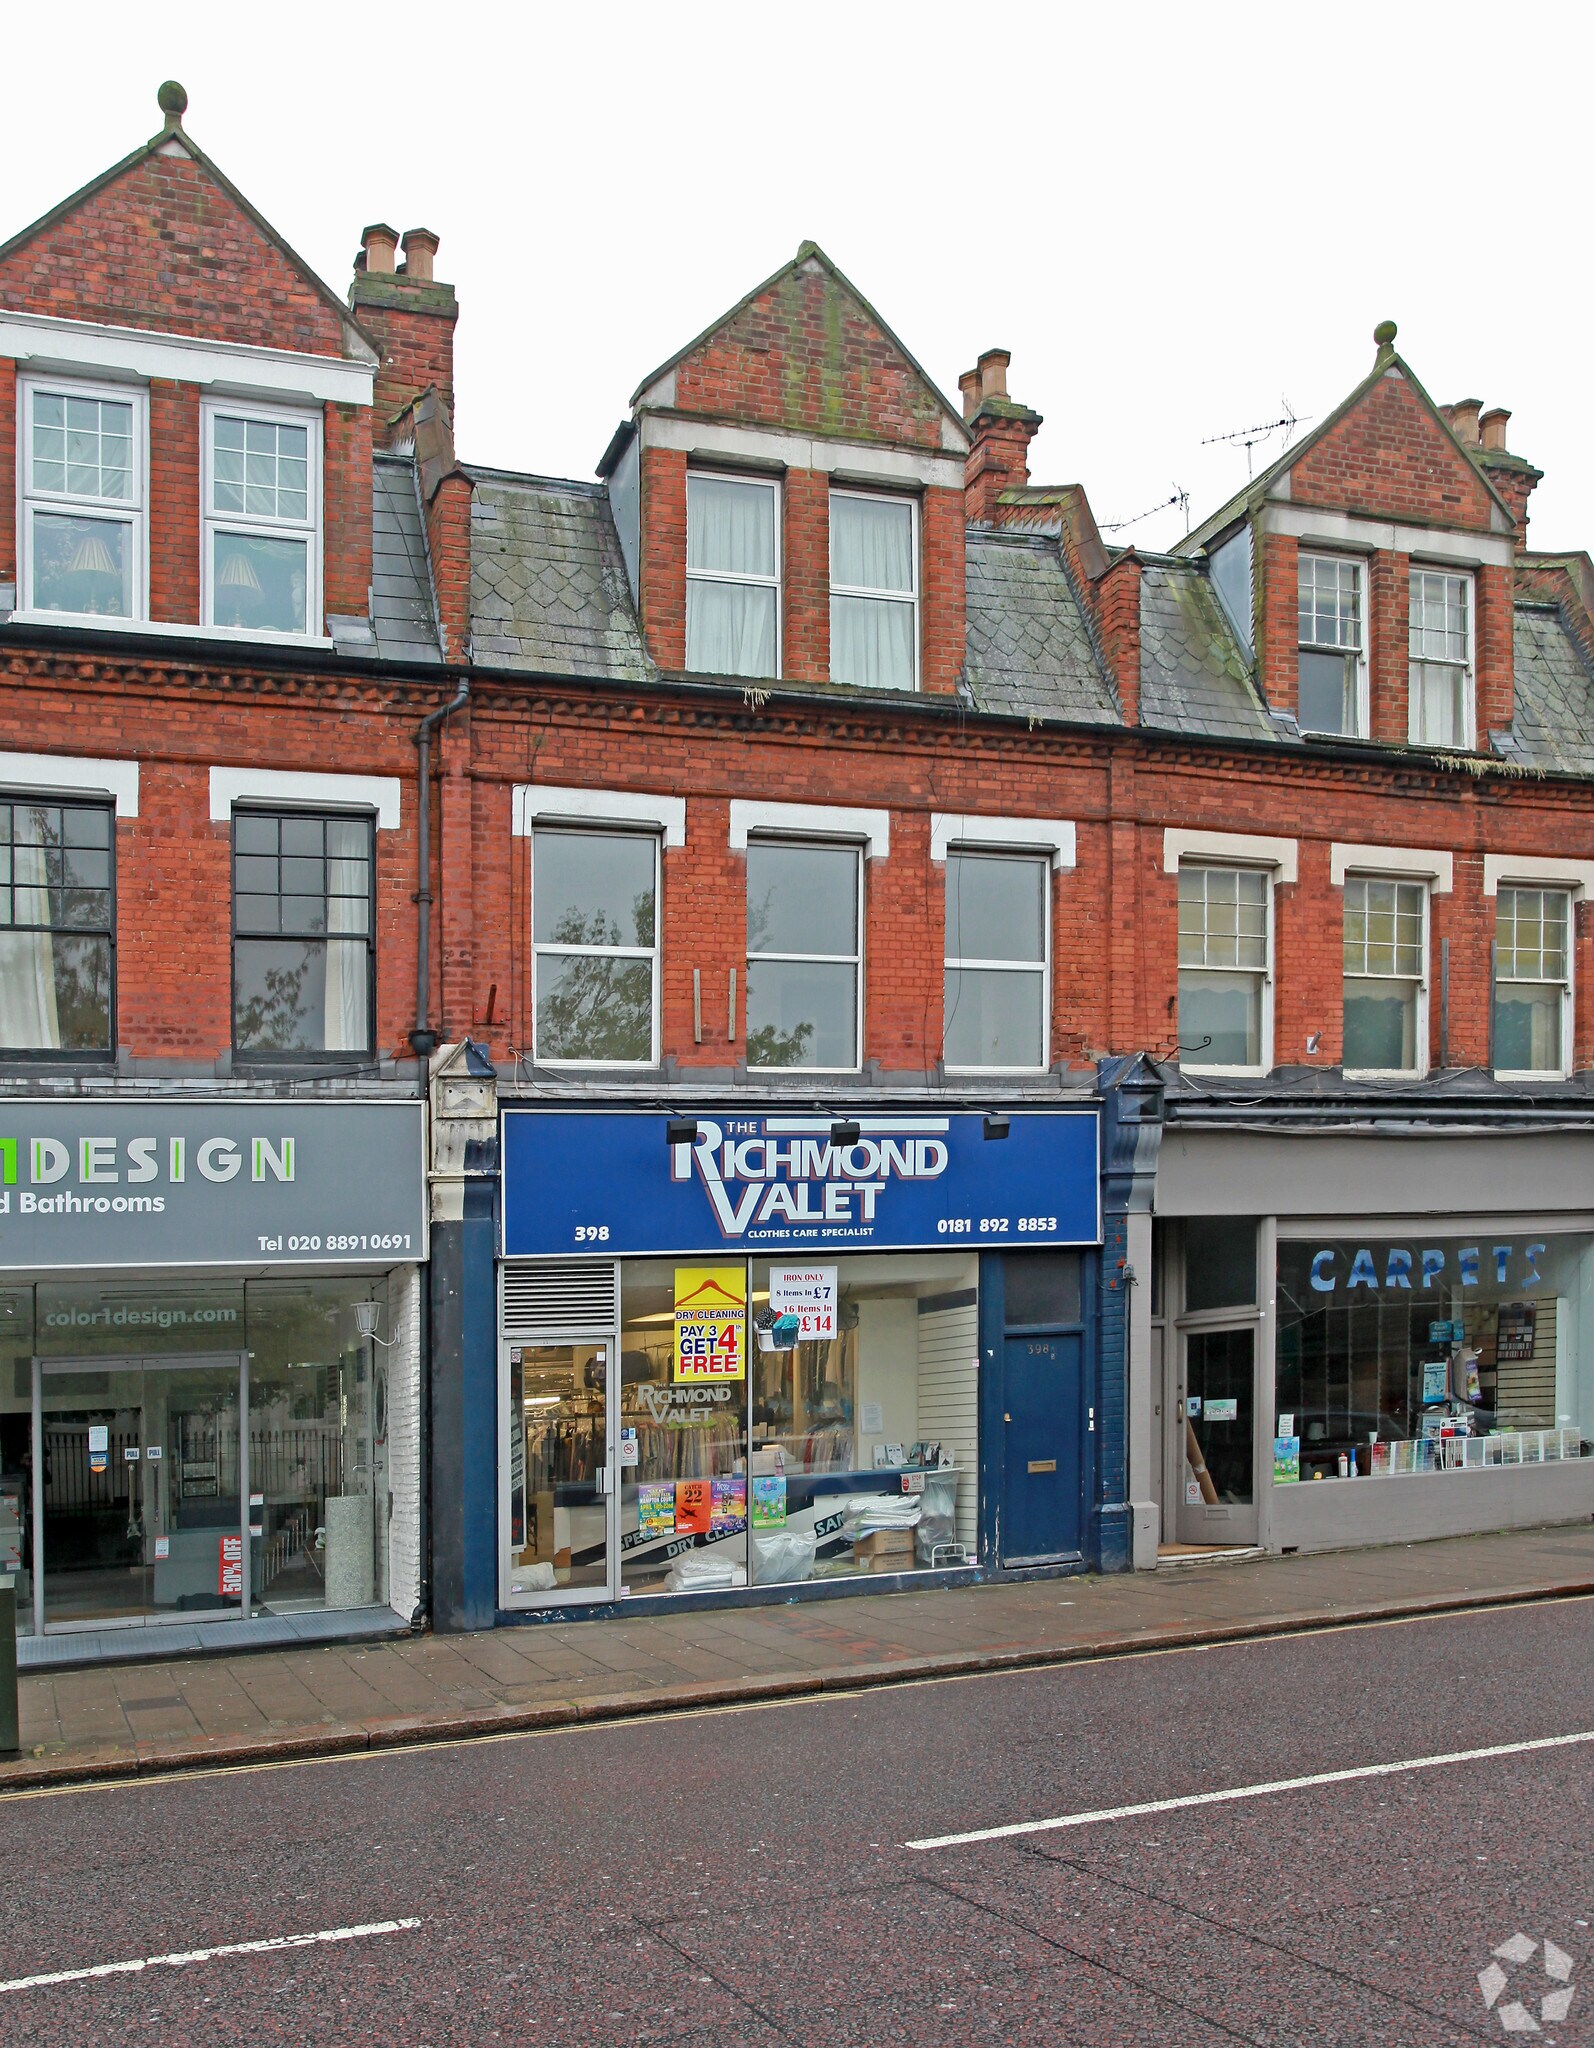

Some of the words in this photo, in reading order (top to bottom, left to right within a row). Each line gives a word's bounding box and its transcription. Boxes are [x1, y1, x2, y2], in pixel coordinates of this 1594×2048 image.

[726, 1121, 758, 1133] THE
[673, 1120, 949, 1181] RICHMOND
[20, 1190, 166, 1214] Bathrooms
[707, 1180, 886, 1234] VALET
[574, 1225, 610, 1242] 398
[747, 1229, 790, 1239] CLOTHES
[792, 1228, 819, 1238] CARE
[821, 1227, 874, 1237] SPECIALIST
[937, 1219, 971, 1233] 0181
[979, 1218, 1009, 1233] 892
[1017, 1217, 1058, 1232] 8853
[257, 1235, 283, 1251] Tel
[287, 1235, 321, 1251] 020
[1310, 1243, 1546, 1292] CARPETS
[783, 1273, 802, 1282] IRON
[804, 1273, 825, 1281] ONLY
[776, 1289, 781, 1297] 8
[783, 1289, 803, 1297] Items
[45, 1306, 237, 1328] color1design.com
[675, 1311, 695, 1320] DRY
[697, 1309, 745, 1320] CLEANING
[784, 1305, 795, 1313] 16
[797, 1304, 821, 1313] Items
[823, 1304, 832, 1312] In
[680, 1325, 705, 1337] PAY
[708, 1325, 717, 1336] 3
[680, 1338, 718, 1355] GET
[1027, 1344, 1049, 1355] 398
[637, 1384, 732, 1405] RICHMOND
[646, 1401, 713, 1424] VALET
[684, 1489, 703, 1503] 22
[223, 1538, 242, 1561] OFF
[666, 1535, 696, 1558] DRY
[222, 1562, 242, 1593] 50%
